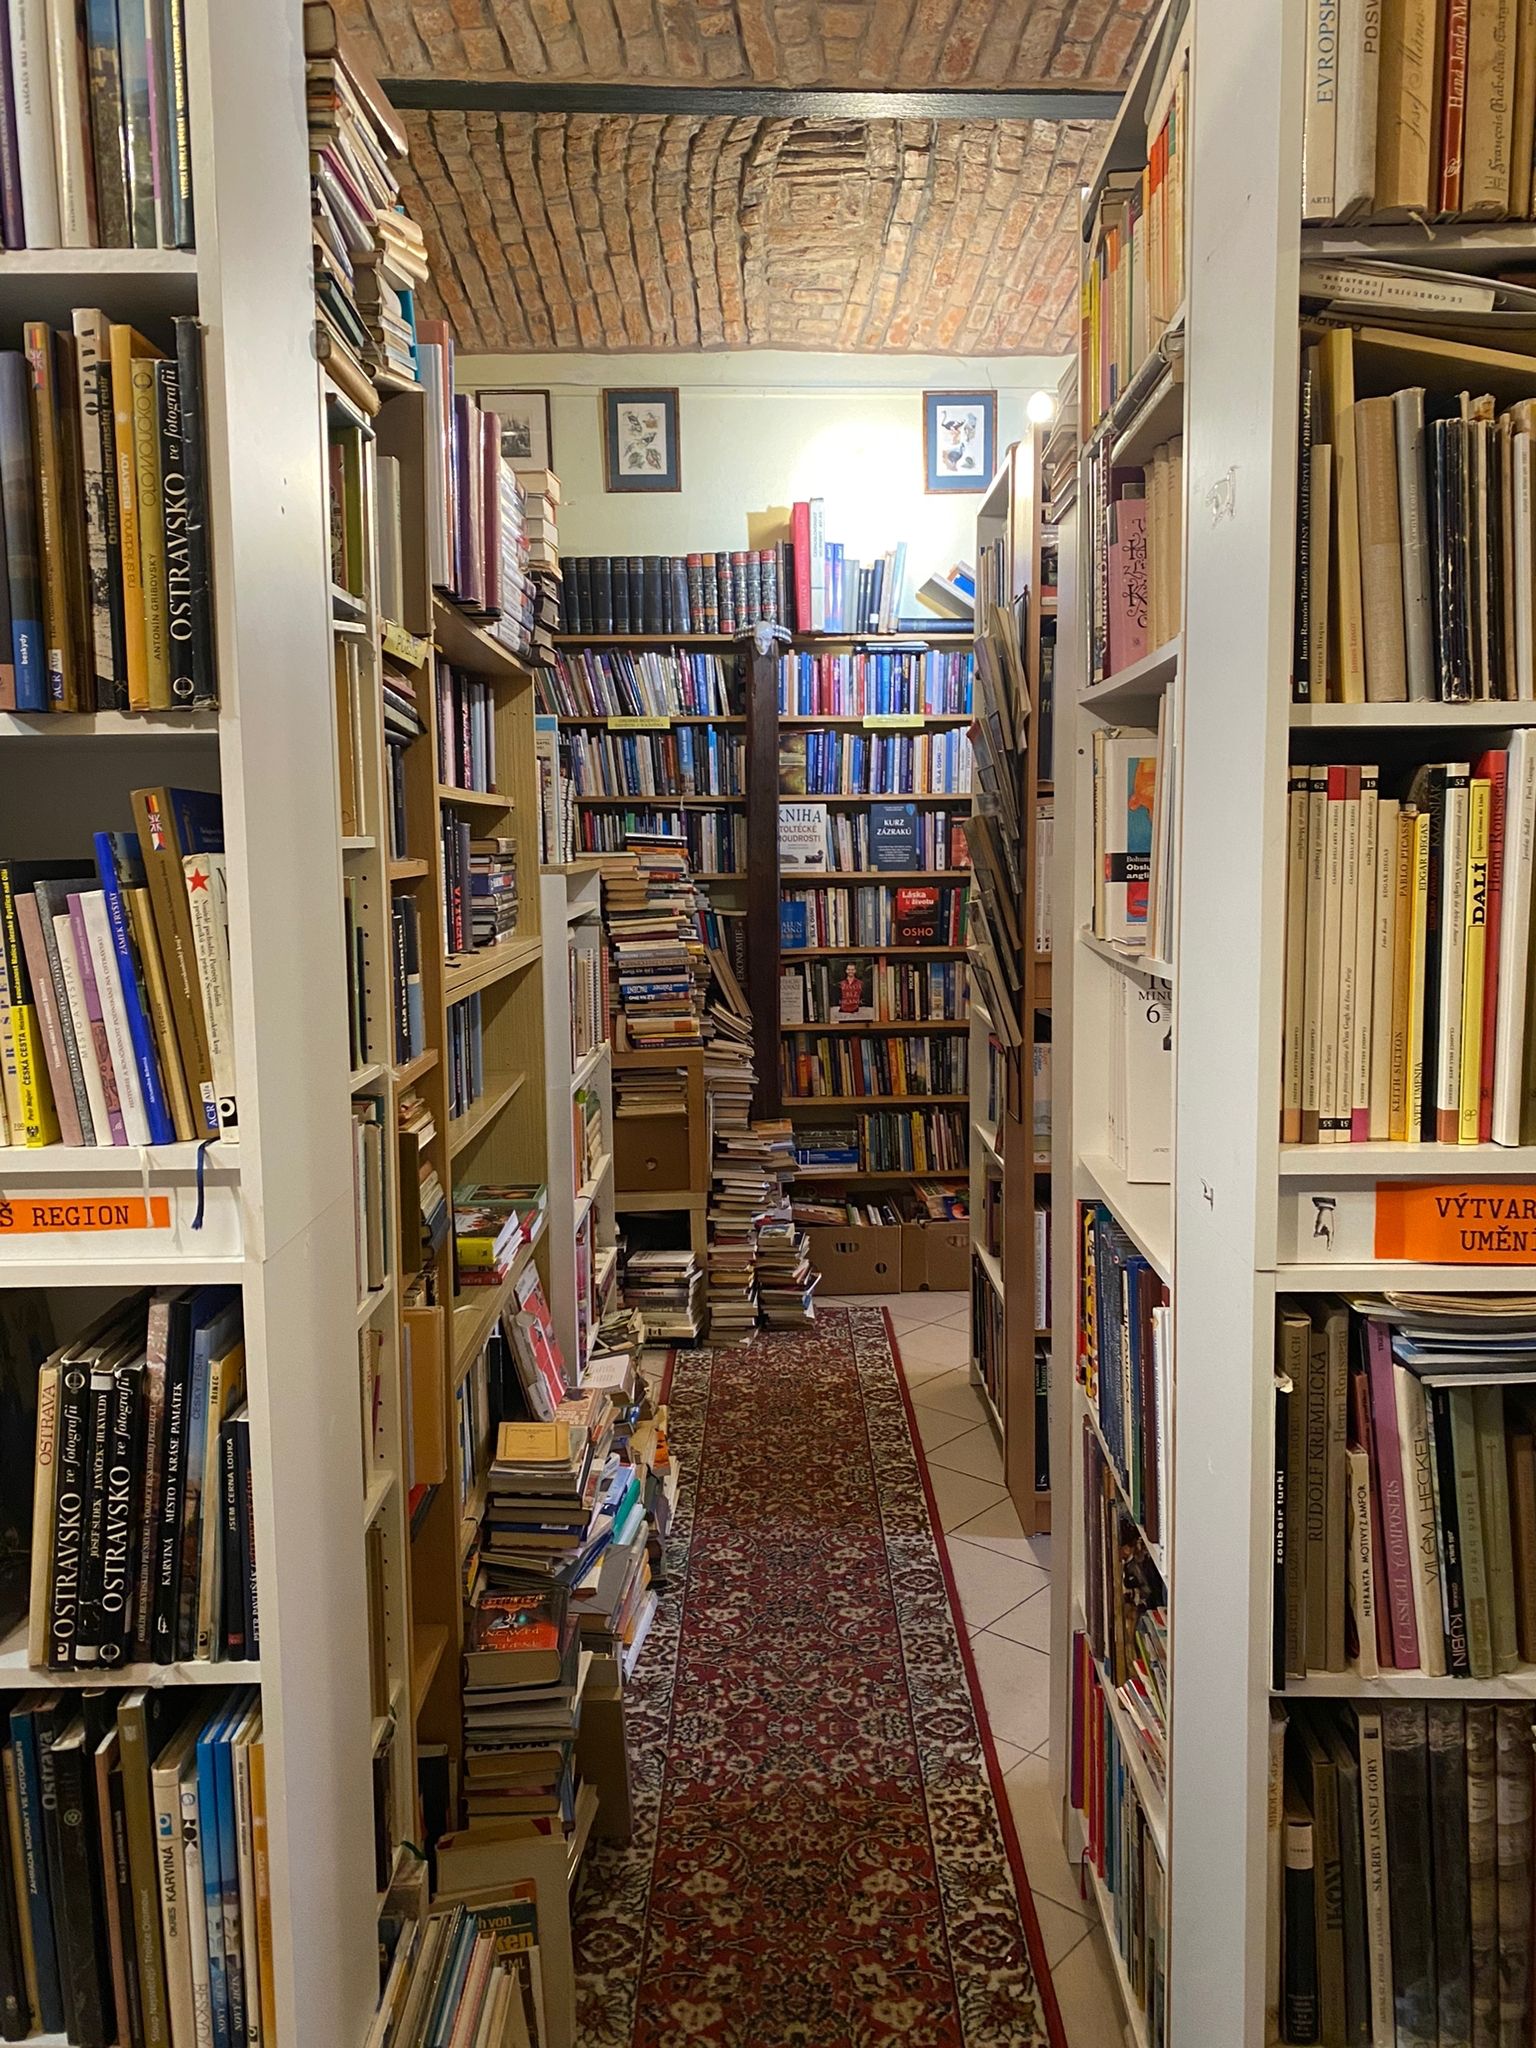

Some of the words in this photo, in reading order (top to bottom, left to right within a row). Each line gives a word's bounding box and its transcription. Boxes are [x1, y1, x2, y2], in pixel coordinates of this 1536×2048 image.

[81, 328, 99, 417] OPAVA
[161, 369, 182, 439] fotografii
[102, 409, 114, 473] karvinský
[136, 397, 157, 507] OLOMOUCKO
[168, 444, 180, 461] ve
[120, 452, 132, 510] BESKYDY
[104, 477, 118, 545] Ostravsko
[163, 472, 192, 641] OSTRAVSKO
[149, 553, 159, 612] GRIBOVSKÝ
[19, 633, 29, 665] beskydy
[151, 614, 161, 661] ANTONÍN
[1316, 650, 1325, 684] Georges
[1349, 648, 1359, 674] James
[53, 674, 62, 699] ACR
[1313, 782, 1325, 790] 62
[1365, 780, 1376, 788] 19
[1454, 778, 1465, 786] 52
[883, 818, 905, 827] KURZ
[1490, 771, 1505, 844] Rousseau
[876, 826, 912, 836] ZÁZRAKŮ
[1419, 823, 1429, 856] DEGAS
[1382, 848, 1390, 872] DEGAS
[1418, 858, 1428, 892] EDGAR
[1489, 850, 1503, 893] Henri
[902, 891, 927, 899] Láska
[1400, 863, 1408, 897] PABLO
[1471, 863, 1487, 924] DALÍ
[108, 891, 122, 924] FRYŠTÁT
[116, 925, 128, 956] ZÁMEK
[902, 927, 934, 937] OSHO
[734, 927, 745, 981] EKONOMIE
[652, 983, 673, 992] Palmer
[1146, 1003, 1161, 1023] 6
[17, 1033, 28, 1057] CESTA
[1393, 1031, 1403, 1074] SUTTON
[19, 1060, 31, 1086] ČESKÁ
[1391, 1078, 1401, 1112] KEITH
[26, 1107, 35, 1121] Petr
[206, 1104, 218, 1127] ACR
[1340, 1120, 1349, 1128] 51
[32, 1205, 129, 1226] REGION
[1335, 1331, 1348, 1397] Rousseau
[169, 1382, 183, 1434] PAMÁTEK
[209, 1375, 219, 1406] TŘINEC
[39, 1384, 55, 1466] OSTRAVA
[96, 1393, 108, 1443] HUKVALDY
[1334, 1402, 1347, 1442] Henri
[62, 1405, 82, 1467] fotografii
[225, 1438, 234, 1469] LOUKA
[168, 1438, 180, 1472] KRÁSE
[67, 1469, 77, 1484] ve
[226, 1472, 236, 1504] ČERNÁ
[1276, 1470, 1285, 1505] turki
[1413, 1437, 1434, 1512] HECKEL
[91, 1499, 103, 1529] SUDEK
[163, 1487, 176, 1523] MĚSTO
[228, 1507, 237, 1531] JSEM
[1308, 1466, 1325, 1541] RUDOLF
[101, 1466, 131, 1612] OSTRAVSKO
[116, 1442, 127, 1456] ve
[1275, 1508, 1284, 1564] zoubeir
[1384, 1479, 1406, 1567] COMPOSERS
[90, 1530, 101, 1558] JOSEF
[1359, 1527, 1370, 1563] MOTIVY
[1420, 1521, 1440, 1585] VILÉM
[53, 1493, 82, 1638] OSTRAVSKO
[161, 1538, 174, 1586] KARVINÁ
[1361, 1569, 1371, 1617] NEPRAKTA
[1394, 1573, 1415, 1654] CLASSICAL
[15, 1740, 27, 1795] FOTOGRAFII
[37, 1731, 58, 1810] Ostrava
[1364, 1757, 1379, 1792] GÓRY
[20, 1796, 28, 1809] VE
[1366, 1795, 1381, 1841] JASNEJ
[21, 1811, 33, 1850] MORAVY
[158, 1846, 177, 1902] KARVINÁ
[1369, 1844, 1383, 1893] SKARBY
[139, 1889, 151, 1931] Olomouc
[167, 1906, 178, 1936] OKRES
[488, 1915, 512, 1928] von
[148, 2016, 160, 2042] Sloup
[192, 1983, 209, 2045] BESKYDY
[216, 2007, 227, 2034] NOVÝ
[232, 2005, 243, 2032] NOVÝ
